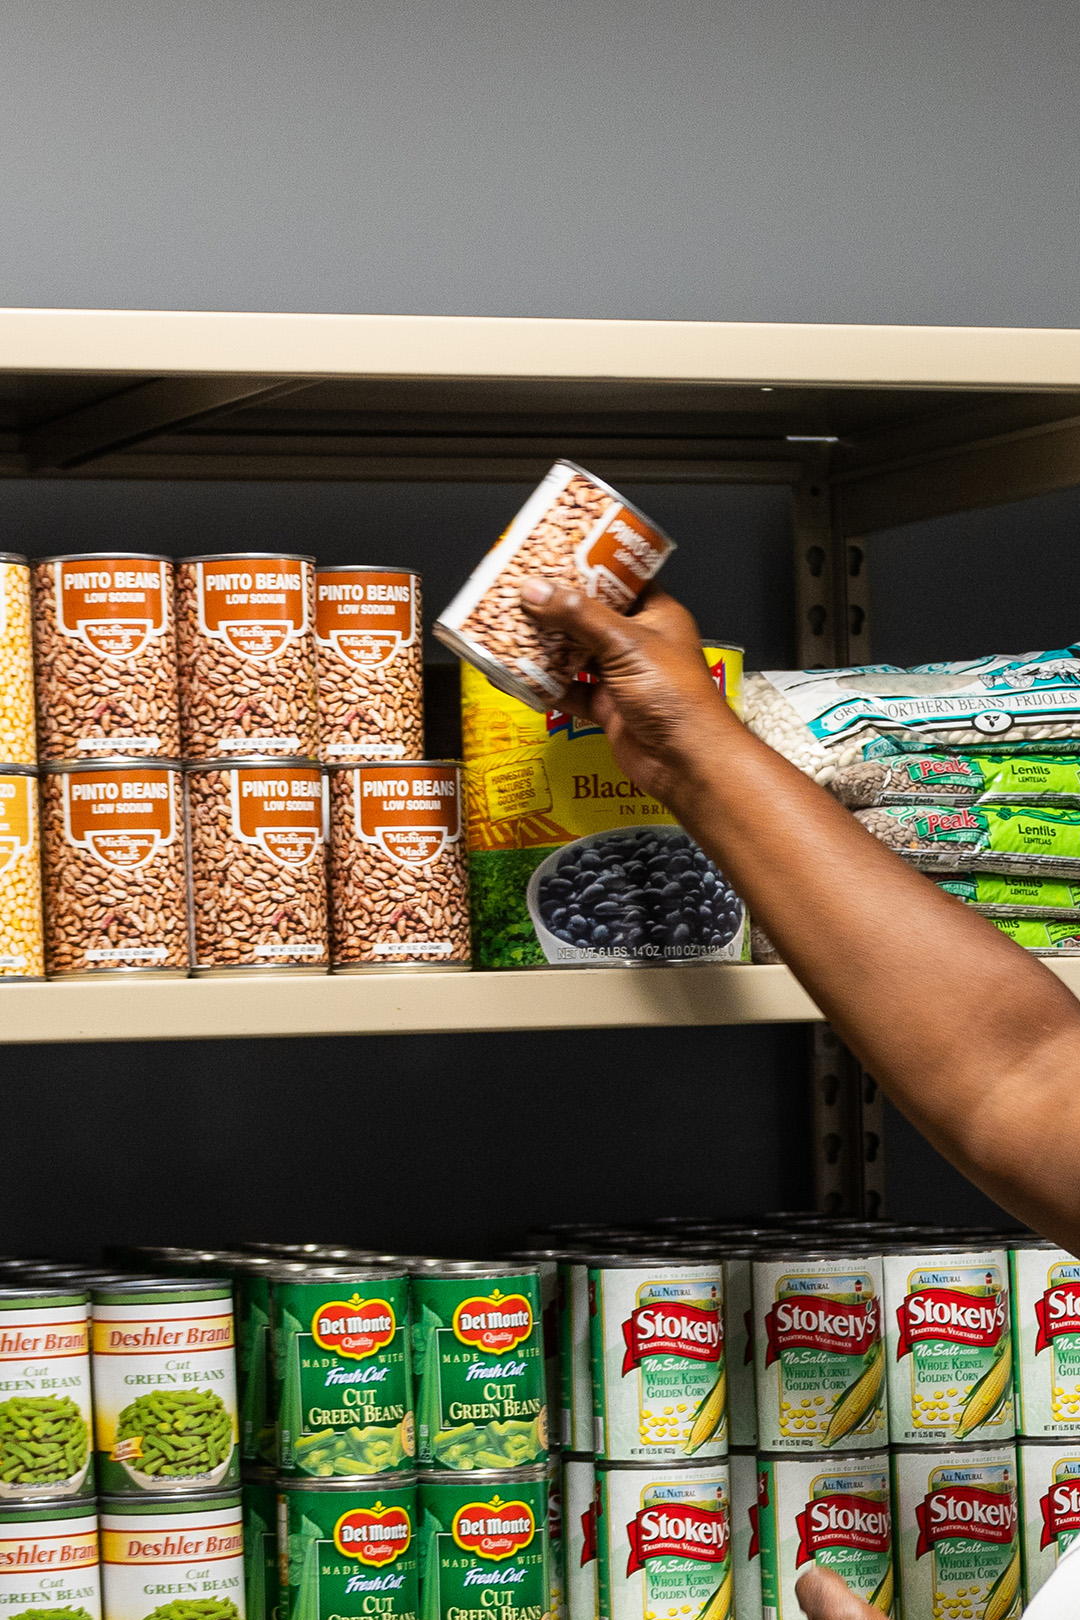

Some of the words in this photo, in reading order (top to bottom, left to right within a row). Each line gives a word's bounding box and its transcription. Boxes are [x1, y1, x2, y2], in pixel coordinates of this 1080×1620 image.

[64, 572, 111, 590] PINTO
[114, 572, 160, 589] BEANS
[205, 573, 252, 591] PINTO
[256, 573, 301, 591] BEANS
[337, 604, 359, 614] LOW
[360, 605, 395, 615] SODIUM
[833, 703, 878, 721] GREA
[959, 698, 1005, 711] BEANS
[1016, 692, 1078, 707] FRIJOLES
[919, 759, 971, 777] Peak
[1012, 765, 1050, 775] Lentils
[572, 774, 646, 799] Black
[383, 800, 404, 811] LOW
[406, 800, 441, 810] SODIUM
[620, 805, 635, 815] IN
[928, 811, 978, 832] Peak
[1018, 824, 1056, 836] Lentils
[1004, 876, 1043, 888] Lentils
[557, 948, 577, 959] NET
[580, 948, 597, 958] WT.
[606, 947, 630, 957] LBS.
[633, 947, 642, 957] 14
[460, 1314, 486, 1331] Del
[488, 1311, 529, 1328] Monte
[908, 1296, 1005, 1334] Stokely's
[320, 1319, 345, 1335] Del
[347, 1316, 392, 1333] Monte
[776, 1303, 876, 1342] Stokely's
[110, 1325, 183, 1348] Deshler
[187, 1320, 230, 1344] Brand
[482, 1332, 513, 1343] Quality
[342, 1337, 374, 1348] Quality
[165, 1360, 190, 1371] Cut
[302, 1358, 338, 1368] MADE
[378, 1353, 403, 1364] WITH
[645, 1358, 663, 1372] No
[663, 1357, 689, 1371] Salt
[23, 1367, 49, 1377] Cut
[124, 1373, 177, 1385] GREEN
[183, 1369, 225, 1382] BEANS
[785, 1367, 816, 1379] WHOLE
[819, 1366, 852, 1378] KERNEL
[646, 1374, 679, 1386] WHOLE
[682, 1373, 710, 1384] KERNEL
[785, 1379, 821, 1391] GOLDEN
[824, 1378, 846, 1390] CORN
[646, 1387, 682, 1398] GOLDEN
[685, 1385, 706, 1396] CORN
[309, 1406, 360, 1425] GREEN
[364, 1404, 403, 1421] BEANS
[342, 1525, 367, 1542] Del
[370, 1522, 408, 1540] Monte
[127, 1536, 204, 1558] Deshler
[442, 1558, 477, 1568] MADE
[517, 1554, 542, 1564] WITH
[186, 1569, 210, 1580] Cut
[650, 1576, 683, 1587] WHOLE
[686, 1574, 715, 1586] KERNEL
[40, 1579, 64, 1589] Cut
[144, 1582, 198, 1595] GREEN
[202, 1577, 240, 1591] BEANS
[57, 1587, 94, 1600] BEANS
[650, 1588, 687, 1600] GOLDEN
[690, 1587, 710, 1598] CORN
